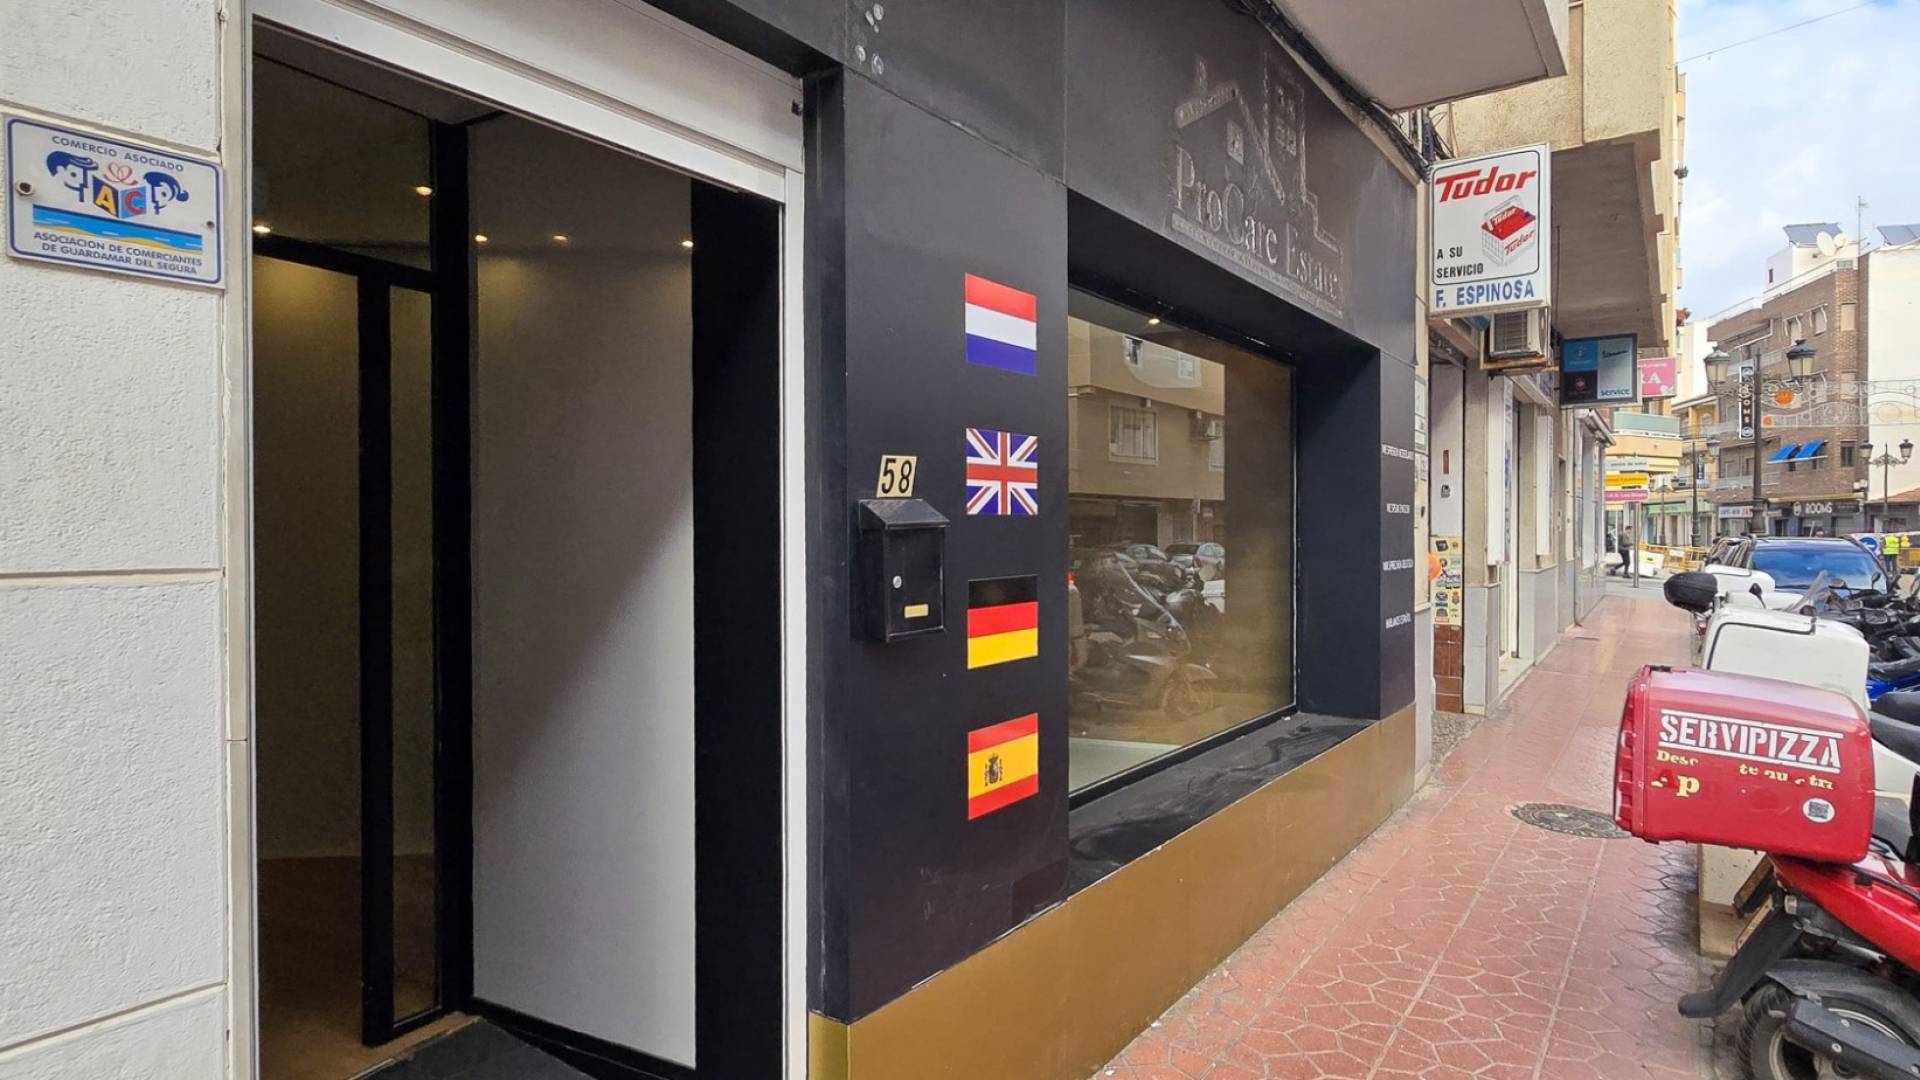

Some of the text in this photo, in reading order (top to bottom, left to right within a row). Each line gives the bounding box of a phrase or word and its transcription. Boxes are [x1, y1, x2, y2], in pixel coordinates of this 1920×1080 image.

[51, 135, 184, 172] COMERCIO ASOCIADO
[1435, 166, 1537, 203] Tudor
[33, 231, 202, 267] ASOCIACION DE COMERCIANTES
[42, 242, 198, 275] DE GUARDAMAR DEL SEGURA
[1437, 246, 1463, 259] A SU
[1504, 230, 1535, 256] Tudor
[1436, 262, 1483, 279] SERVICIO
[1435, 279, 1535, 308] F. ESPINOSA
[881, 457, 913, 494] 58
[1805, 502, 1833, 514] ROOMS
[1660, 714, 1841, 769] SERVIPIZZA
